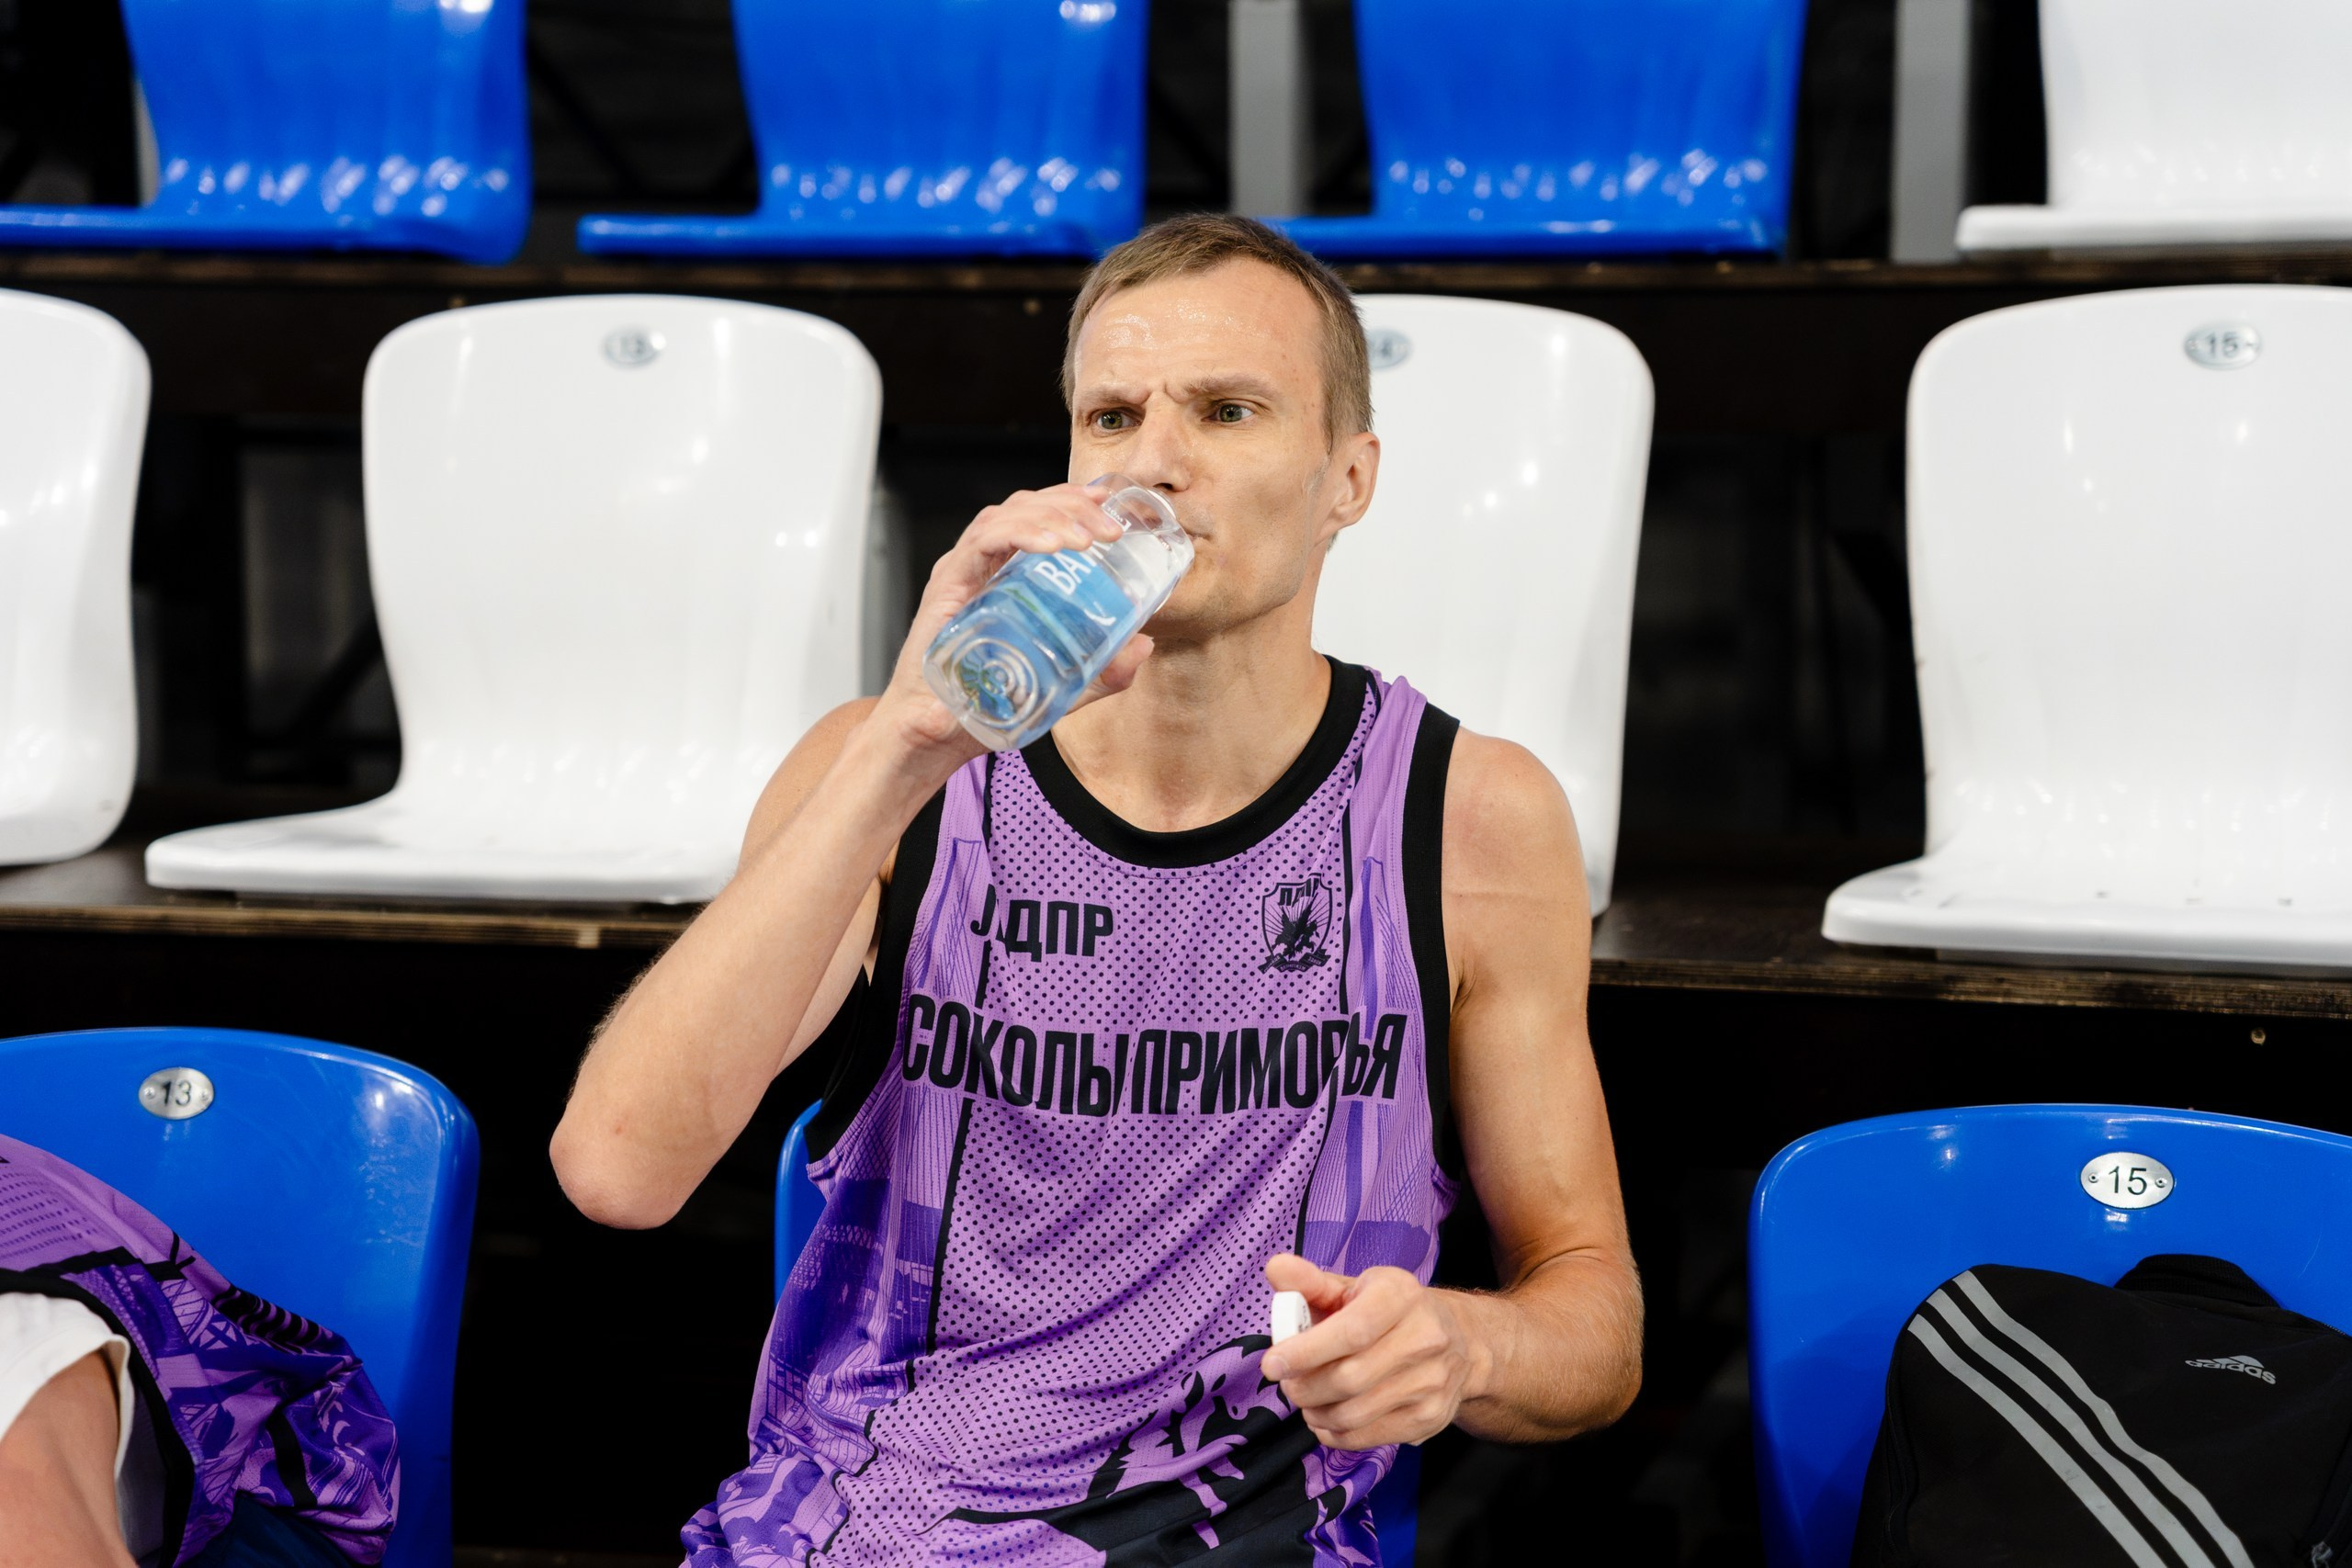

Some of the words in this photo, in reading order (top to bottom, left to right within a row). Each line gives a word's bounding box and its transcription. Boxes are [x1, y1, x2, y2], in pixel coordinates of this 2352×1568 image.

[902, 994, 1129, 1117] СОКОЛЫ
[1131, 1012, 1408, 1114] ПРИМОРЬЯ
[162, 1080, 191, 1106] 13
[2109, 1166, 2147, 1195] 15
[2185, 1359, 2277, 1385] adidas
